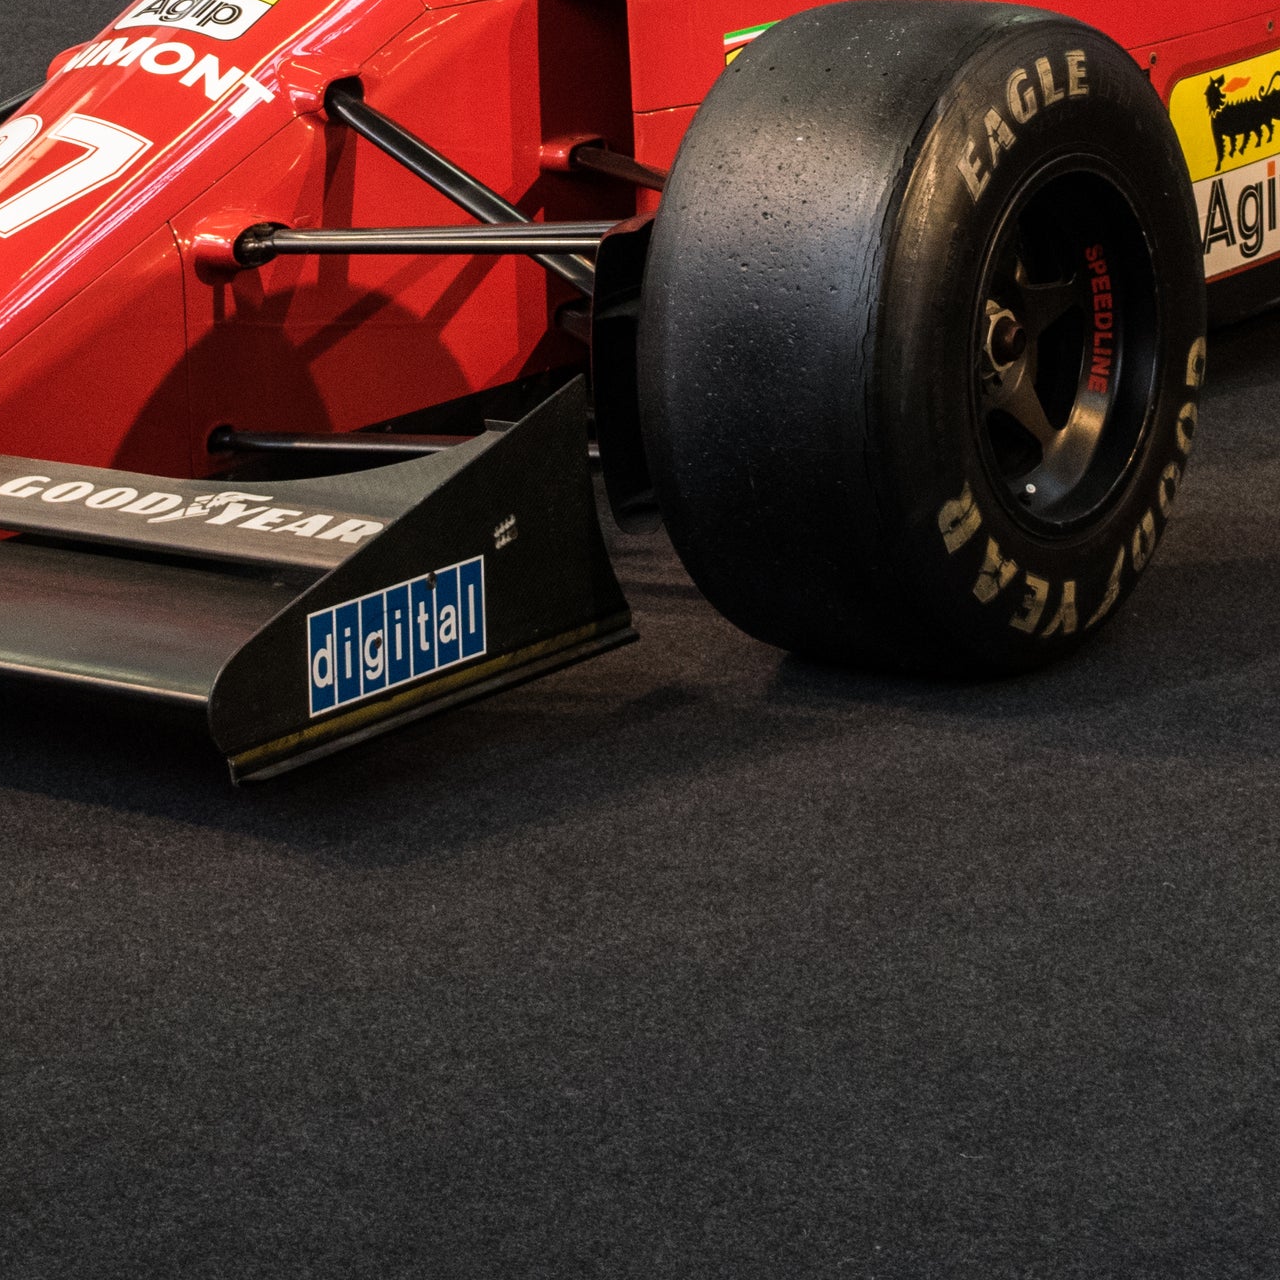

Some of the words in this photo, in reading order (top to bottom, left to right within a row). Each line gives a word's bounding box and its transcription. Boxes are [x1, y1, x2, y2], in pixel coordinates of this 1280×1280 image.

[955, 48, 1090, 205] EAGLE
[1085, 243, 1114, 394] SPEEDLINE
[313, 583, 478, 689] digital
